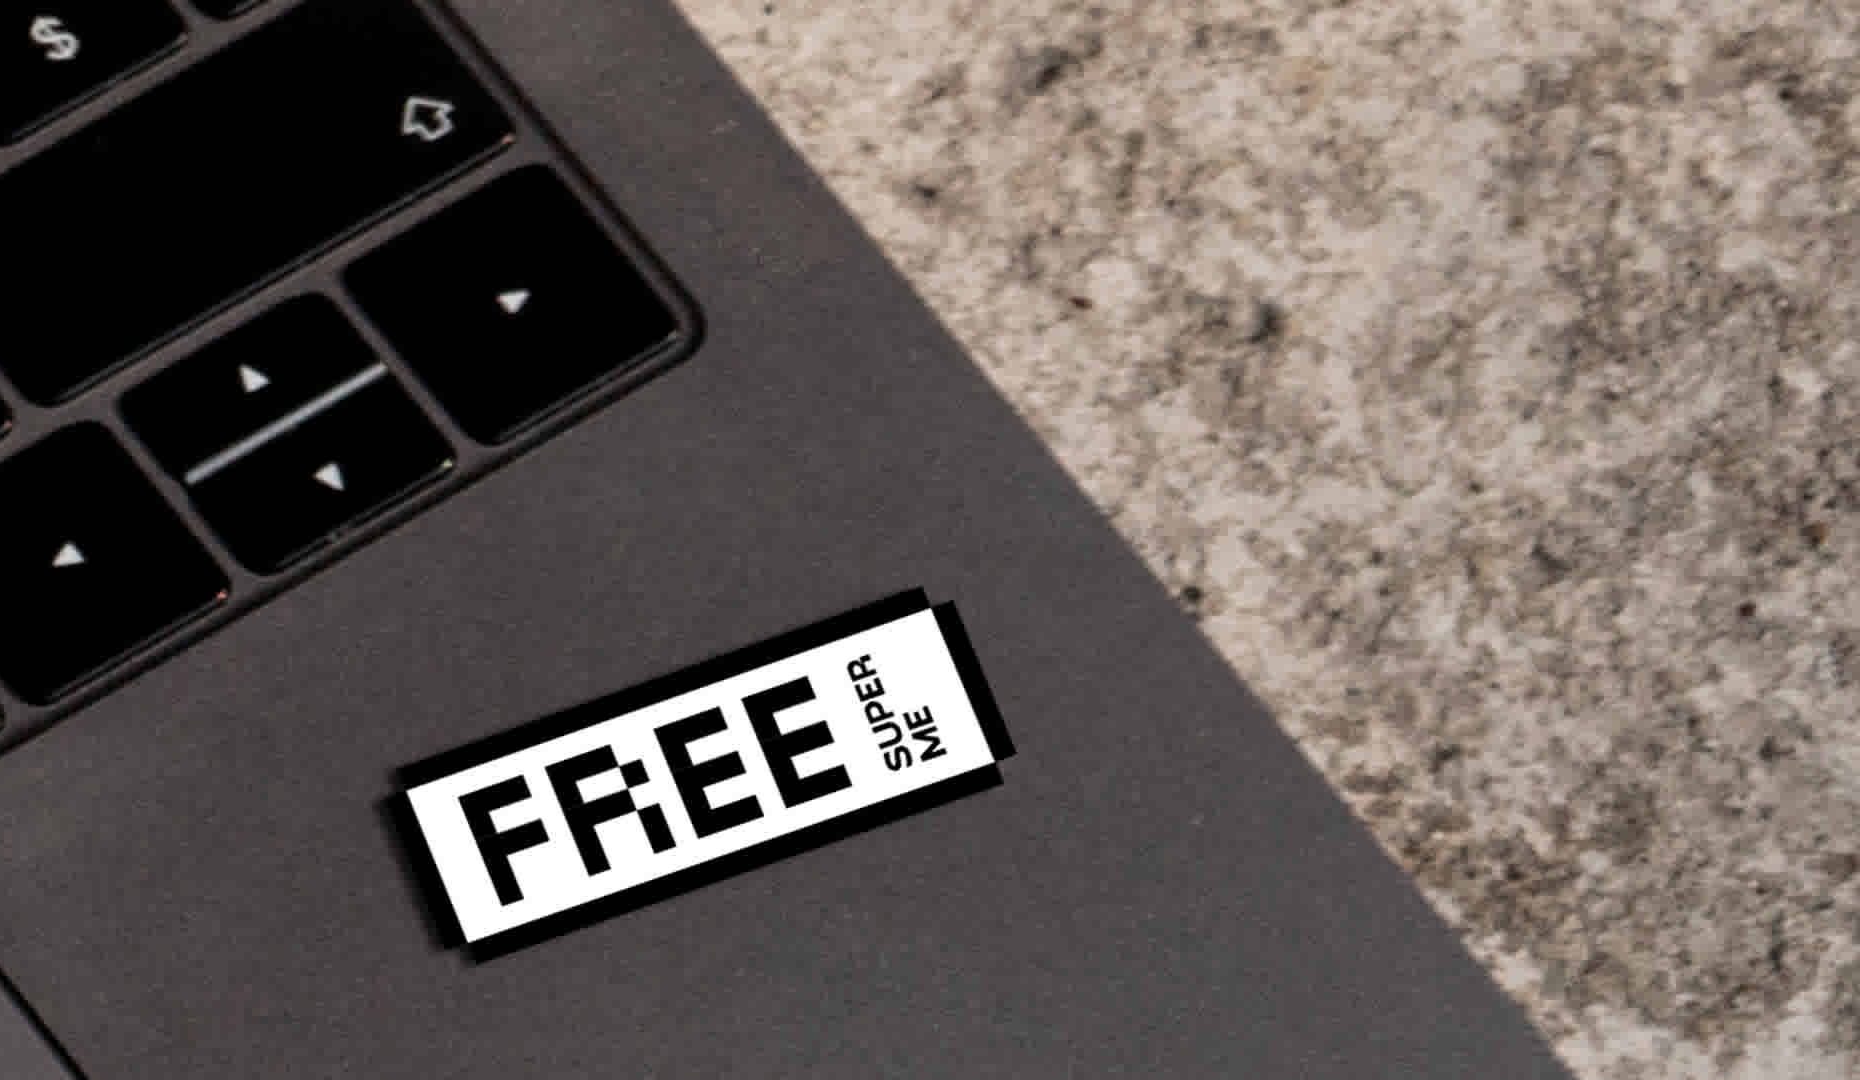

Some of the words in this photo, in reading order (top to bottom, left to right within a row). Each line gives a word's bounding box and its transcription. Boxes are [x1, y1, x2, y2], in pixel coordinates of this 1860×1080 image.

[30, 17, 78, 61] $
[847, 654, 913, 772] SUPER
[902, 705, 947, 762] ME
[458, 676, 852, 906] FREE
